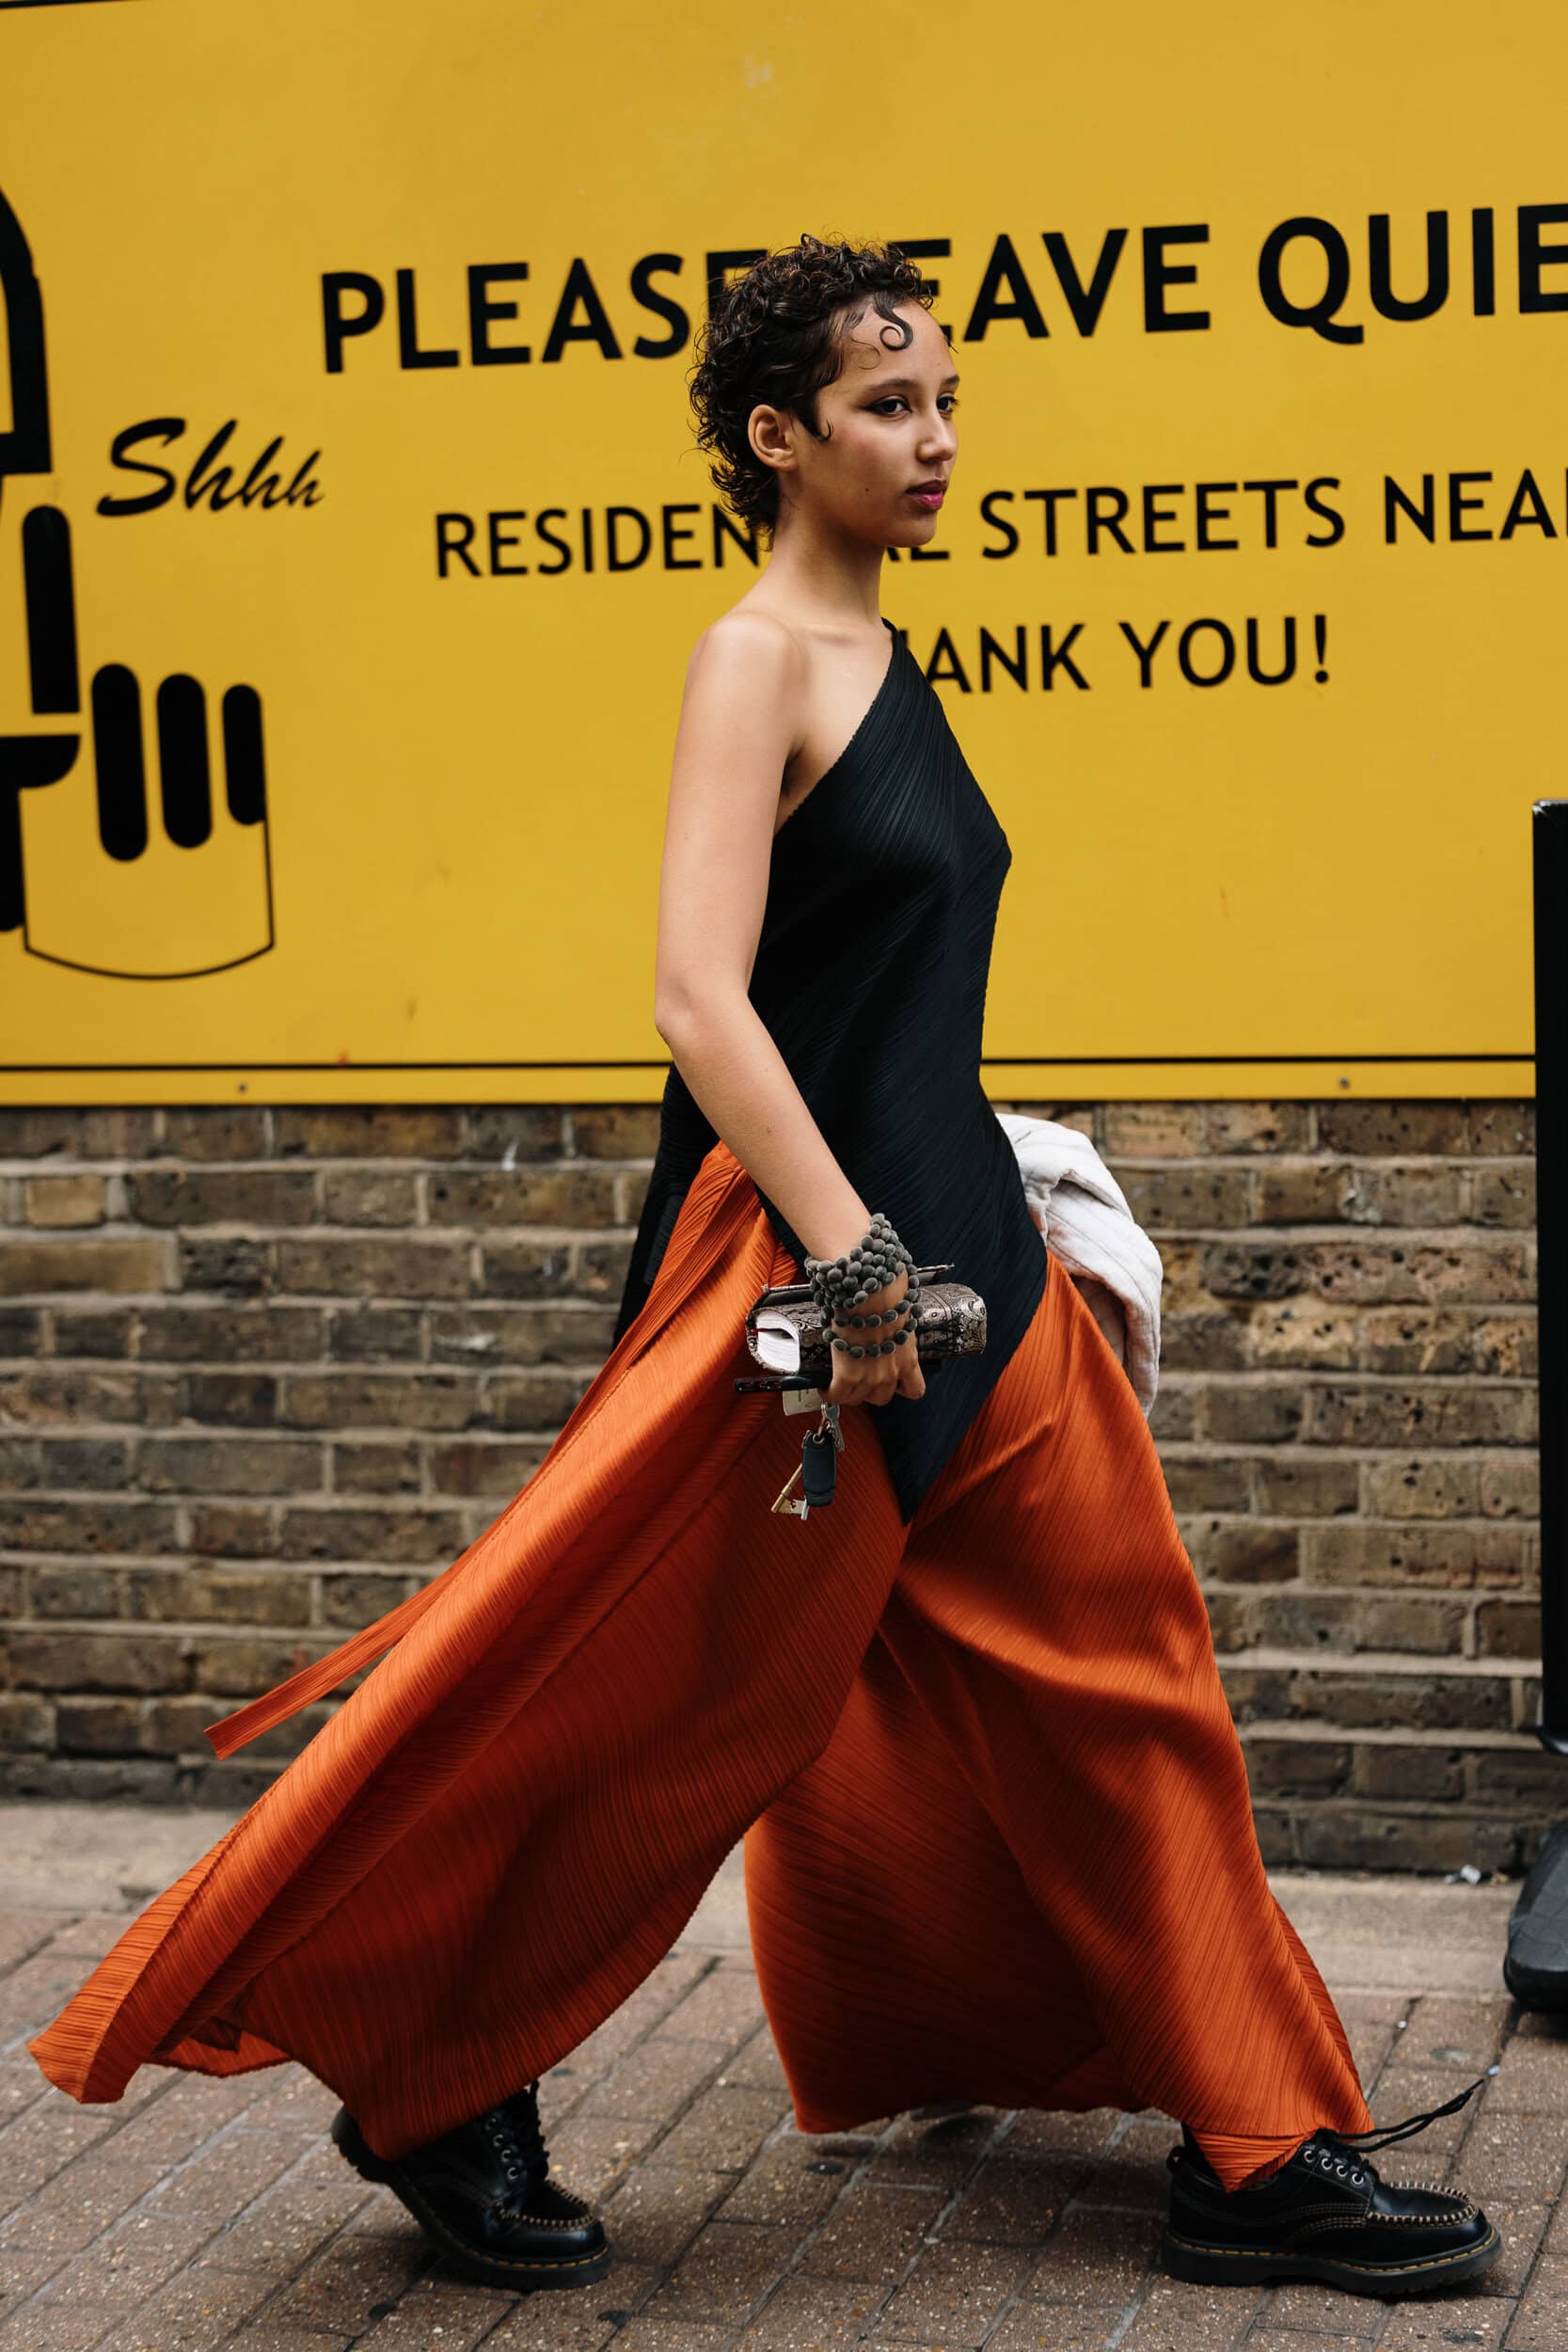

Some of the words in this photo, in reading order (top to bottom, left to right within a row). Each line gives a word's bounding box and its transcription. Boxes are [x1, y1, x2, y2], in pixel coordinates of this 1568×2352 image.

[886, 222, 1212, 345] EAVE
[96, 417, 325, 517] Shhh
[979, 477, 1346, 560] STREETS
[1384, 468, 1568, 545] NEA
[898, 623, 1091, 694] ANK
[1118, 613, 1329, 689] YOU!
